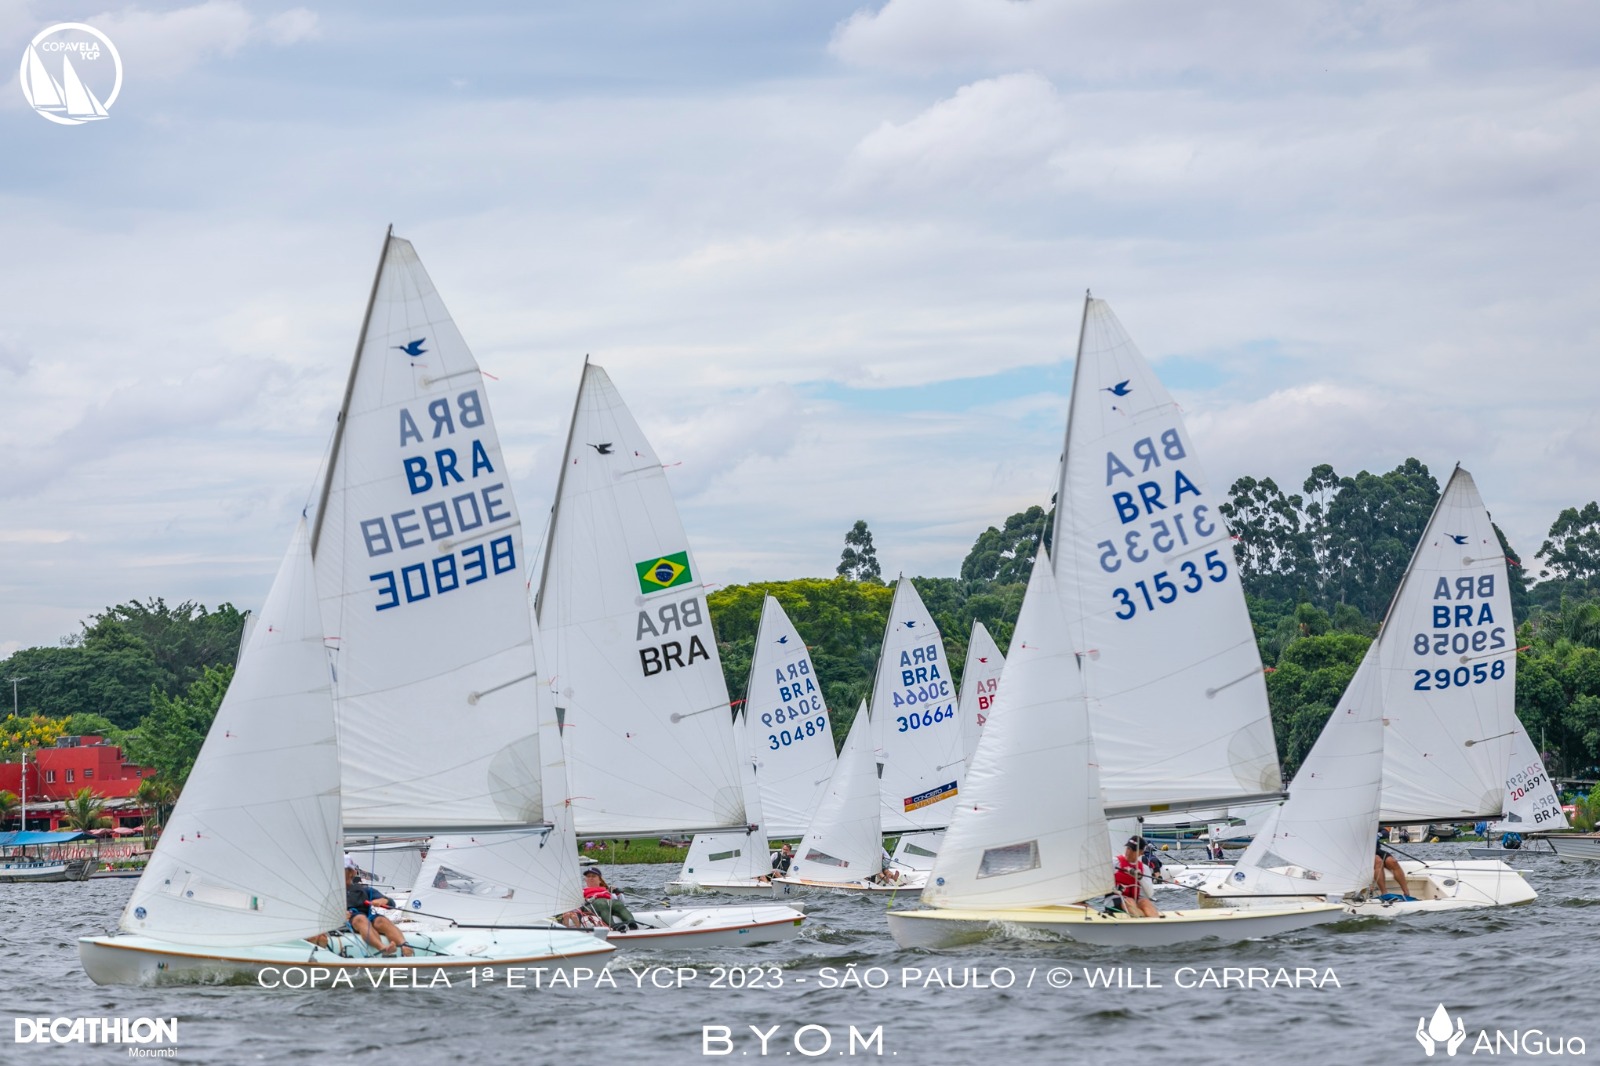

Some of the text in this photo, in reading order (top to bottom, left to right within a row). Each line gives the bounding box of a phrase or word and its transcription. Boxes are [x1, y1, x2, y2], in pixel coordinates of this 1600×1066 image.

[403, 439, 494, 495] BRA
[1112, 470, 1202, 524] BRA
[369, 534, 516, 611] 30838
[1112, 549, 1228, 620] 31535
[1433, 603, 1494, 628] BRA
[639, 635, 710, 677] BRA
[779, 677, 815, 703] BRA
[902, 664, 940, 686] BRA
[1414, 659, 1505, 690] 29058
[768, 716, 826, 750] 30489
[896, 704, 954, 732] 30664
[1510, 773, 1547, 801] 204591
[1534, 806, 1560, 823] BRA
